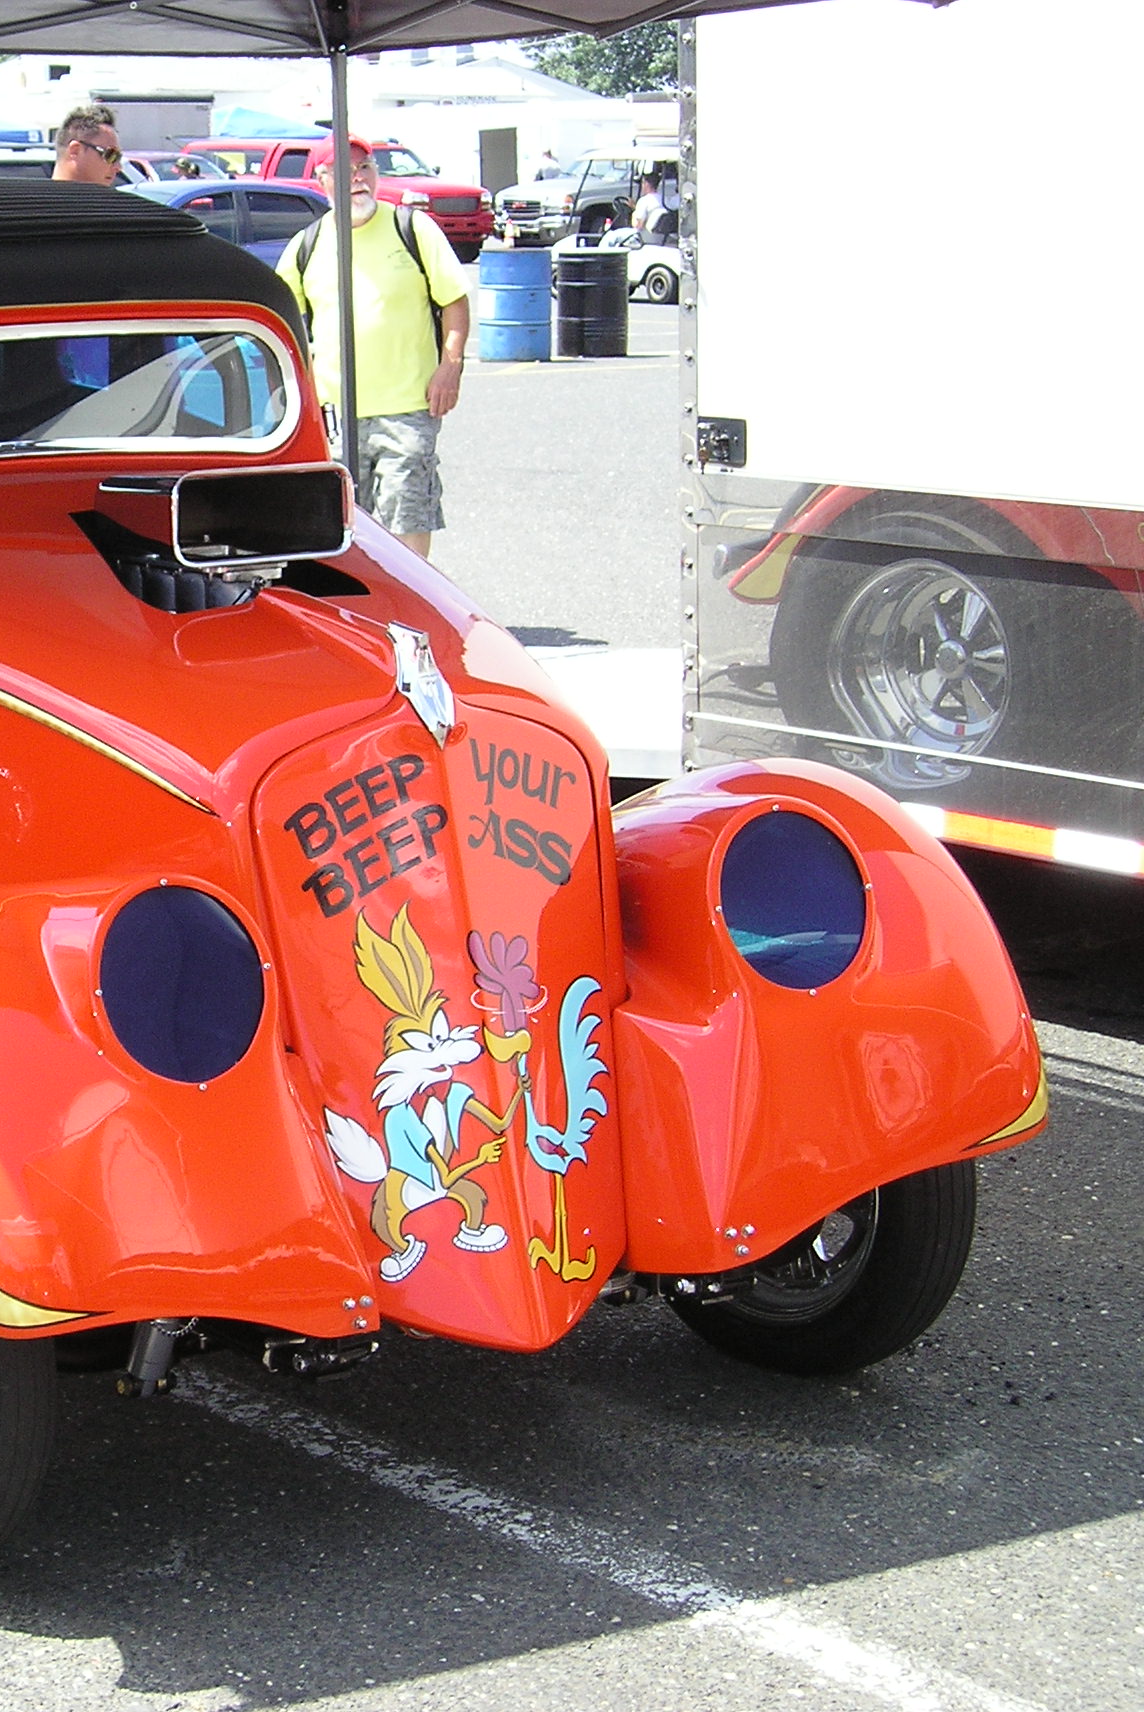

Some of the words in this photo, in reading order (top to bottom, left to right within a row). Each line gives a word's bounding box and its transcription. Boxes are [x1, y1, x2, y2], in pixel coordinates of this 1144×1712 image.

[283, 753, 426, 861] BEEP
[301, 802, 449, 919] BEEP
[467, 809, 574, 886] ASS
